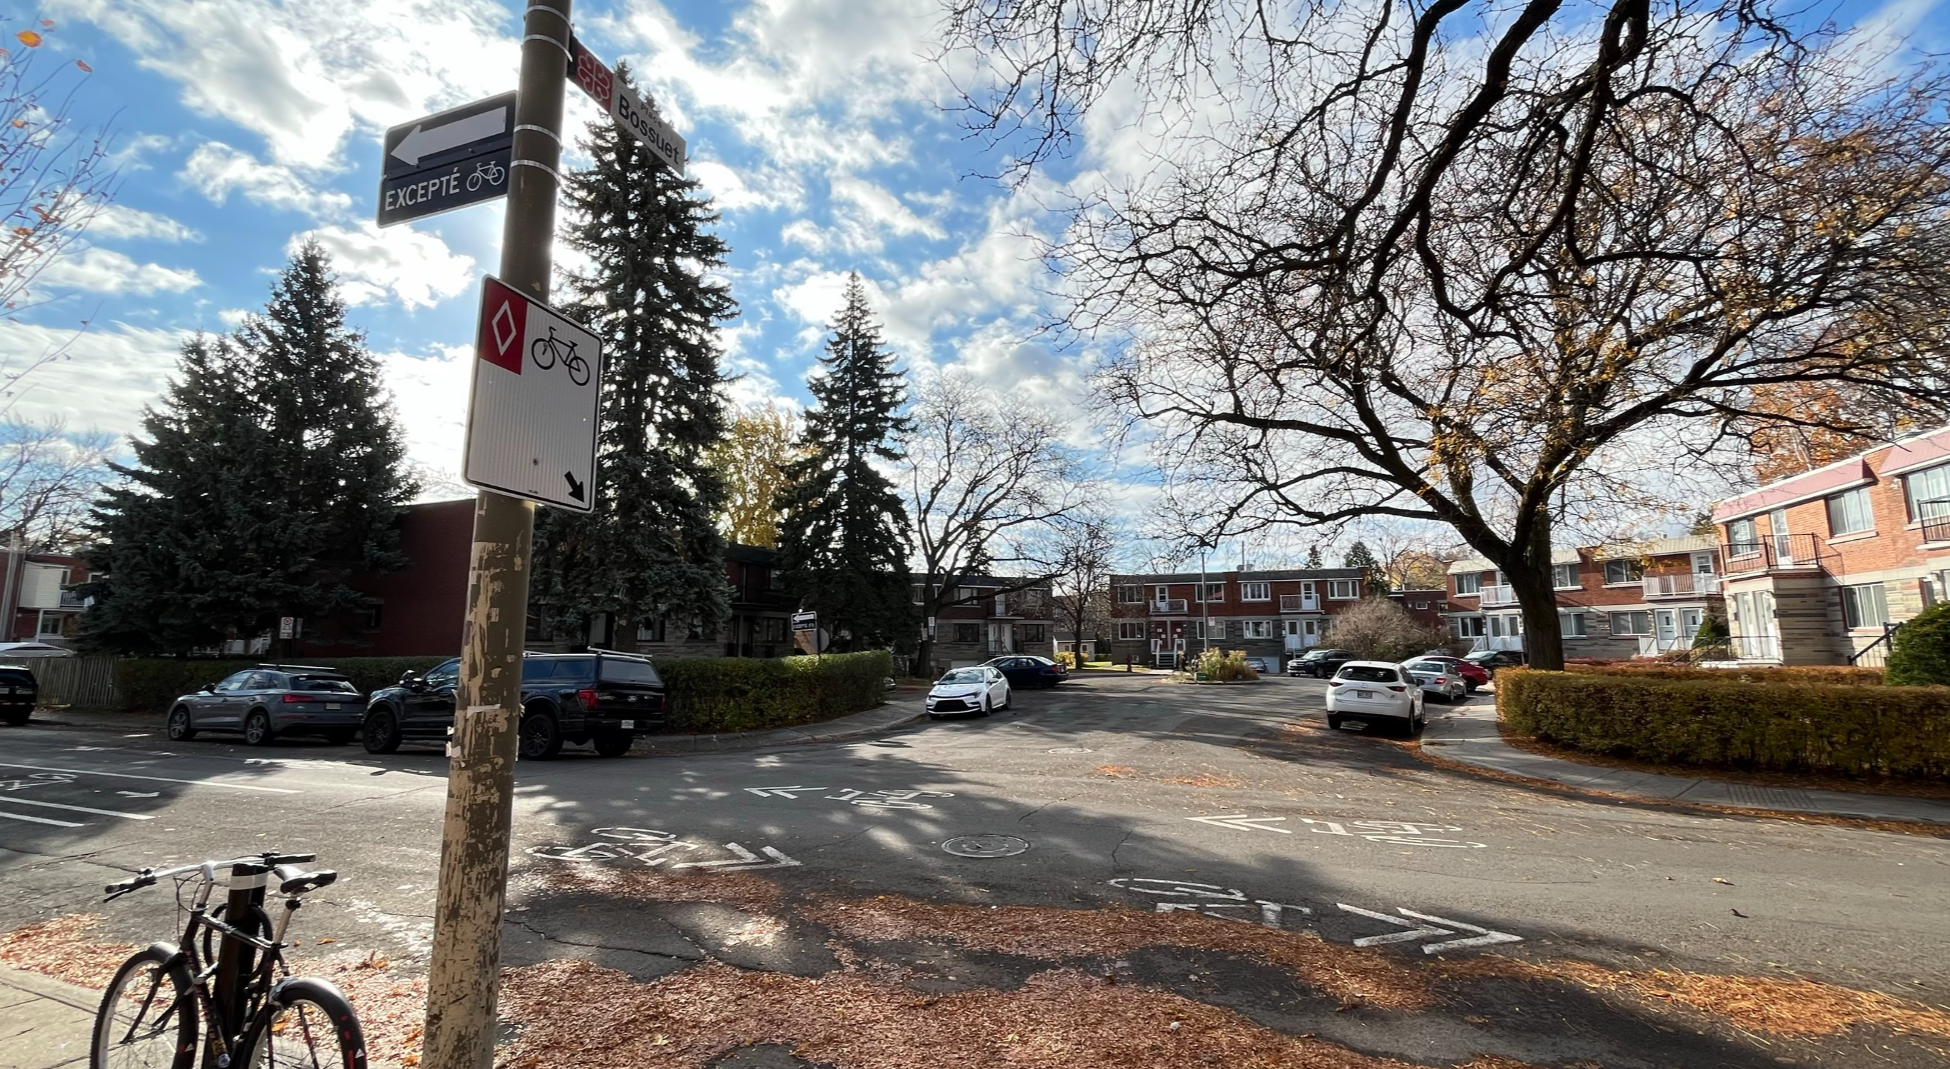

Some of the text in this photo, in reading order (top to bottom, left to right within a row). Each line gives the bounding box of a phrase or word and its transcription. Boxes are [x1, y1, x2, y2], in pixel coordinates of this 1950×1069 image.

[619, 94, 679, 165] Bossuet
[640, 103, 662, 128] Place
[385, 167, 460, 211] EXCEPTÉ
